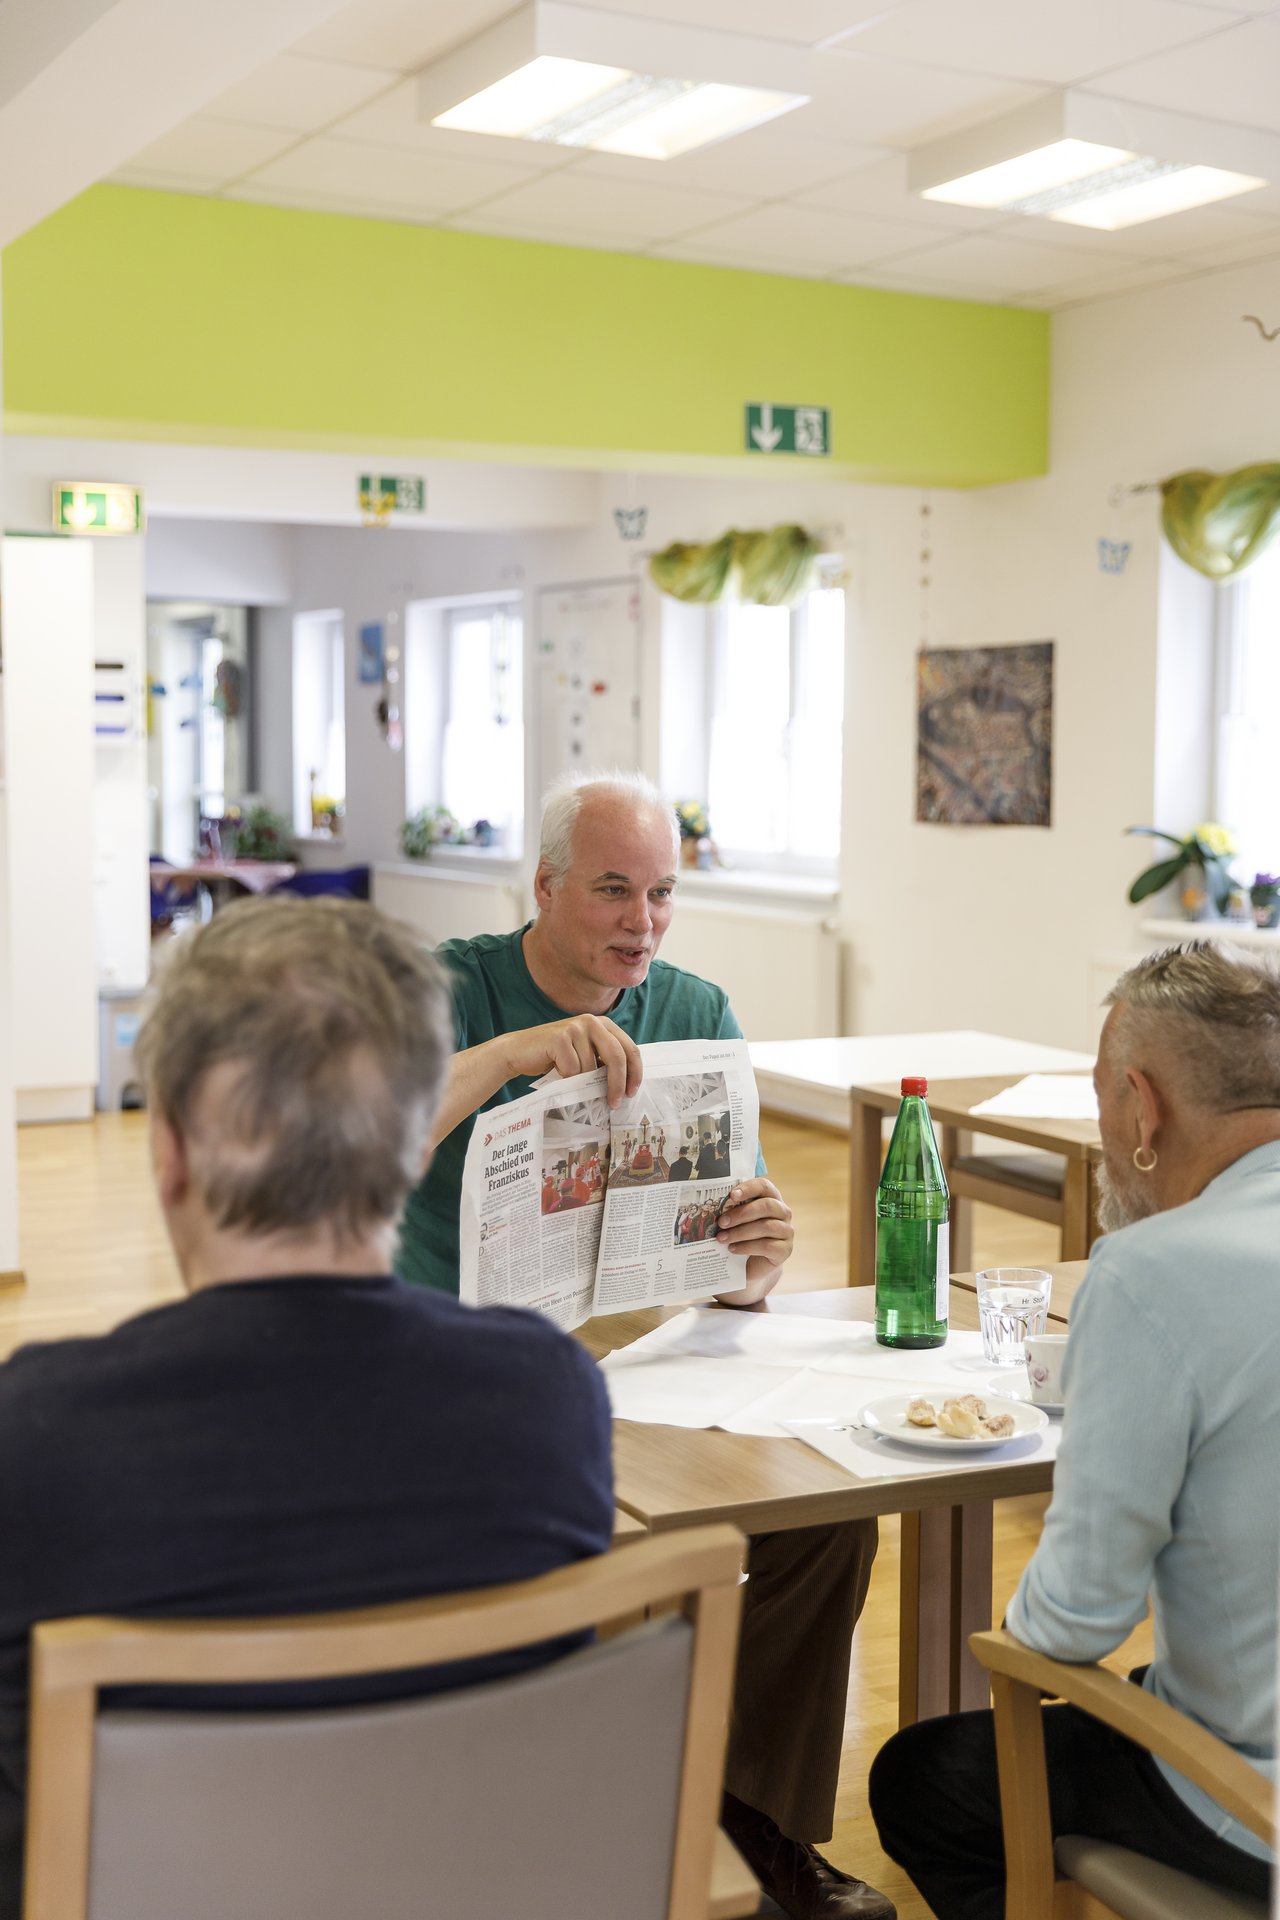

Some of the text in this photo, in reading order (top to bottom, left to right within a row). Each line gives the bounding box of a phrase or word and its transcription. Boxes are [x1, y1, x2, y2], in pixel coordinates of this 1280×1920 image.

[494, 1118, 531, 1141] DAS THEMA
[492, 1140, 528, 1161] Der lange
[484, 1151, 534, 1179] Abschied von
[488, 1167, 530, 1192] Franziskus
[656, 1259, 663, 1271] 5
